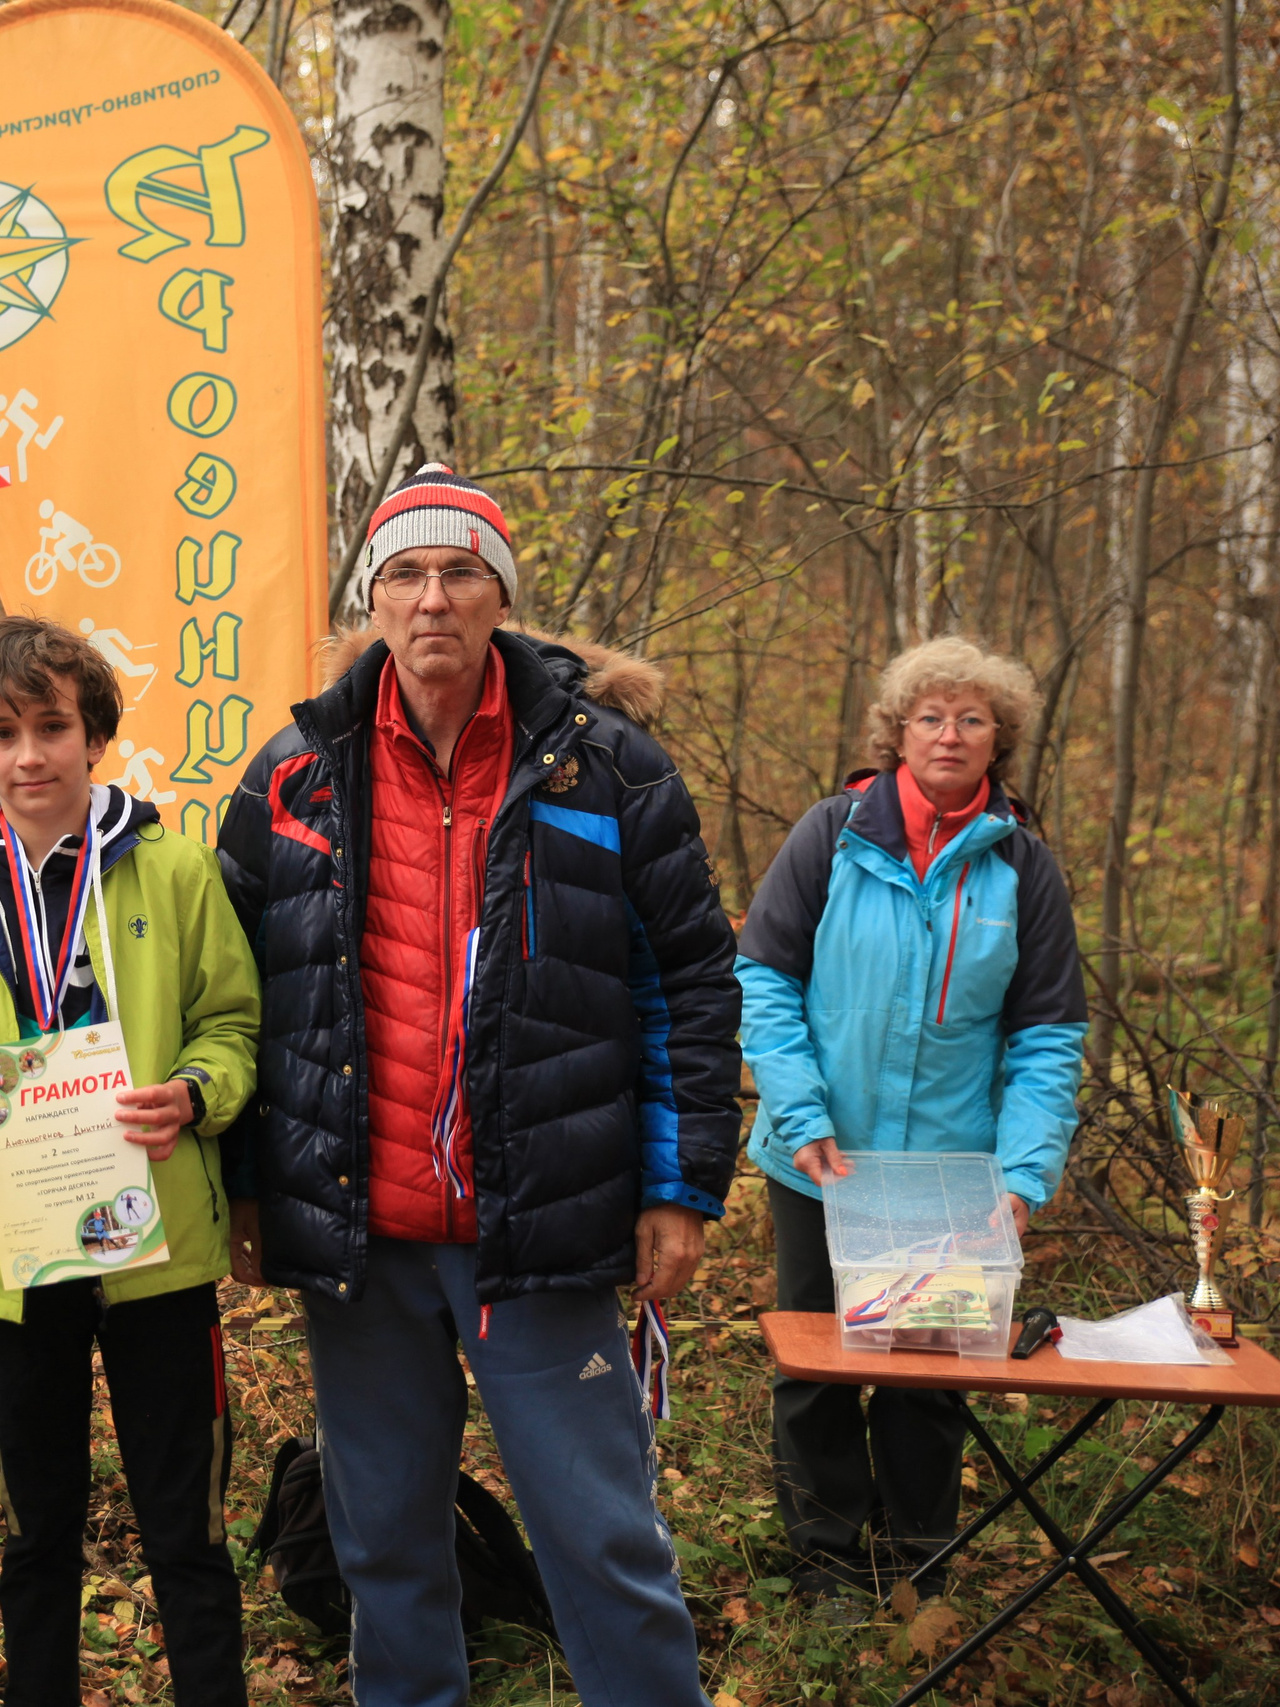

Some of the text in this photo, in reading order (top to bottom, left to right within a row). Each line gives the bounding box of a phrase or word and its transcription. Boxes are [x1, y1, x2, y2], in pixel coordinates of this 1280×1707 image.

[20, 1069, 128, 1107] ГРАМОТА
[25, 1106, 79, 1123] НАГРАЖДАЕТСЯ
[52, 1148, 57, 1157] 2
[62, 1147, 79, 1155] место
[26, 1162, 69, 1174] традиционных
[70, 1152, 115, 1166] соревнованиях
[24, 1174, 62, 1187] спортивному
[64, 1164, 115, 1179] ориентированию
[86, 1192, 95, 1200] 12
[578, 1363, 612, 1381] adidas
